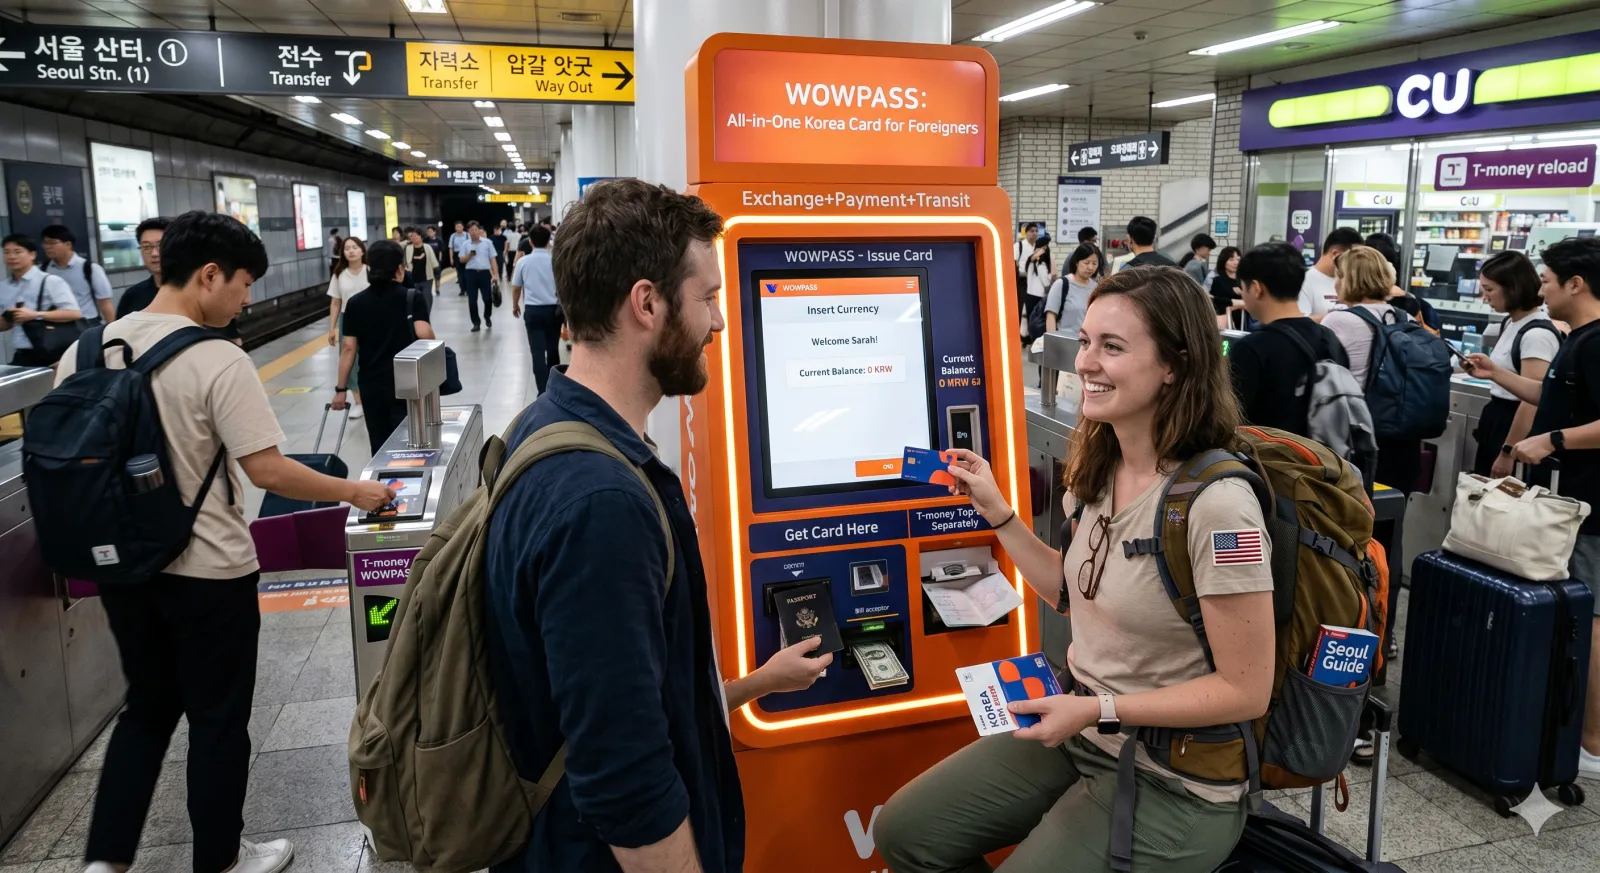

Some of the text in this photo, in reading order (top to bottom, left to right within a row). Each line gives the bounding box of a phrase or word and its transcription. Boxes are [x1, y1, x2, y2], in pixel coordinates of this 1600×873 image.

[34, 35, 85, 61] 서울
[277, 45, 323, 69] 전수
[419, 50, 479, 72] 자력소
[507, 54, 546, 75] 압갈
[37, 64, 150, 84] Seoul Stn. (1)
[269, 72, 331, 87] Transfer
[421, 76, 478, 90] Transfer
[535, 79, 593, 95] Way Out
[785, 82, 927, 110] WOWPASS:
[1397, 68, 1470, 118] CU
[726, 113, 979, 136] All-in-One Korea Card for Foreigners
[1472, 157, 1589, 179] T-money reload
[742, 190, 971, 210] Exchange+Payment+Transit
[784, 250, 855, 263] WOWPASS
[867, 249, 900, 262] Issue
[903, 249, 933, 261] Card
[782, 283, 818, 292] WOWPASS
[807, 304, 879, 316] Insert Currency
[811, 335, 878, 346] Welcome Sarah!
[942, 354, 974, 363] Current
[799, 368, 830, 377] Current
[832, 366, 866, 376] Balance:
[874, 365, 893, 374] KRW
[941, 366, 976, 375] Balance:
[916, 510, 955, 520] T-money
[784, 522, 879, 542] Get Card Here
[931, 519, 979, 532] Separately
[361, 558, 410, 568] T-money
[786, 593, 817, 604] PASSPORT
[1325, 640, 1369, 659] Seoul
[1322, 655, 1365, 673] Guide
[979, 690, 999, 728] KOREA
[997, 708, 1009, 726] SIM
